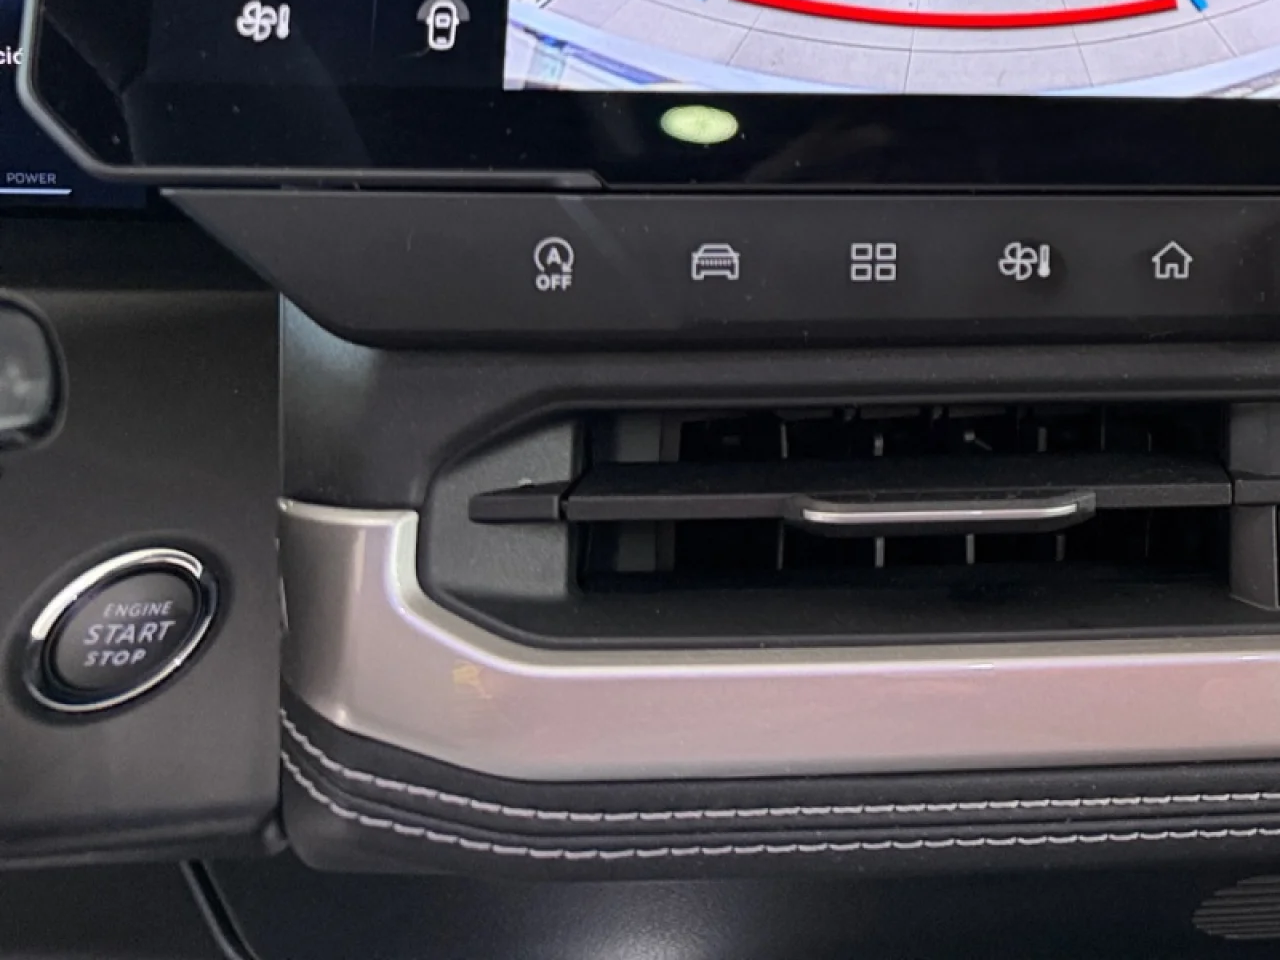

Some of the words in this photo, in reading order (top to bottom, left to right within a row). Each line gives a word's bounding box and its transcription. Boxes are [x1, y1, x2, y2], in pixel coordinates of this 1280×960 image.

[6, 171, 57, 185] POWER
[535, 273, 573, 292] OFF
[103, 600, 173, 618] ENGINE
[82, 620, 177, 646] START
[84, 648, 148, 668] STOP
